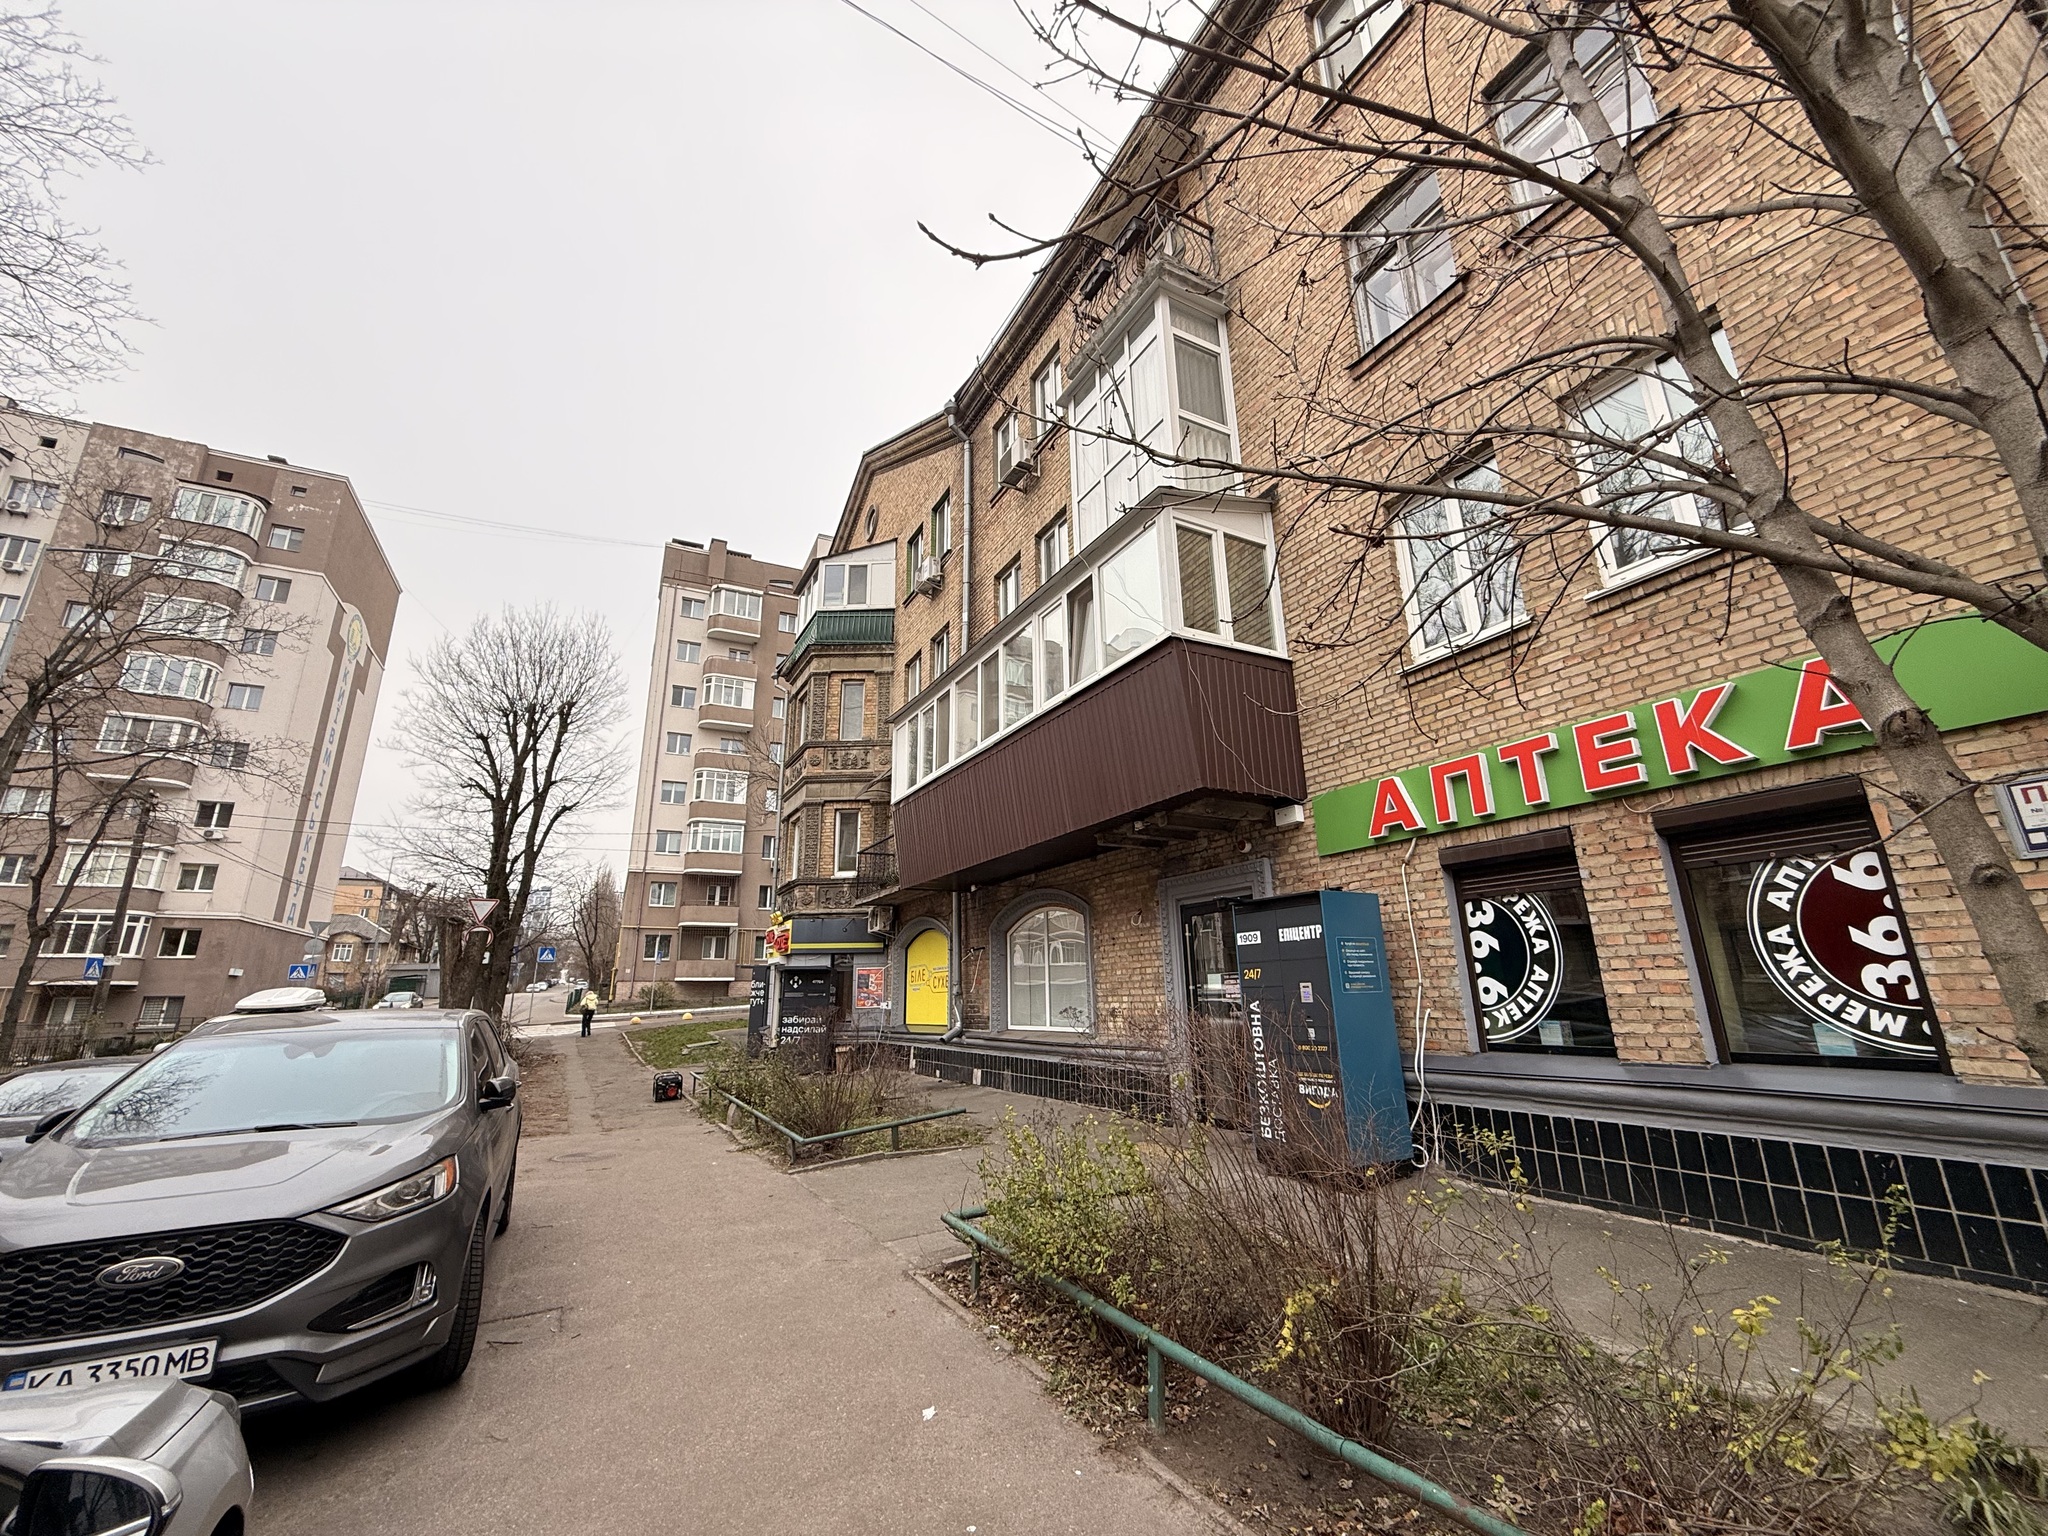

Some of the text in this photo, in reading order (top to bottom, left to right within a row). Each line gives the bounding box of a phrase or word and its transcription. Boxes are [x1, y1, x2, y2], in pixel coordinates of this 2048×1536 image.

[1368, 655, 1874, 840] АПТЕКА
[1766, 854, 1817, 912] АПТ
[1239, 933, 1259, 943] 1909
[1278, 925, 1322, 942] ЕПІЦЕНТР
[1491, 893, 1551, 1028] РЕЖА АПТЕК
[910, 968, 926, 984] БІЛЕ
[1766, 924, 1908, 1037] МЕРЕЖА
[781, 1025, 827, 1034] надсилай
[115, 1263, 165, 1283] Ford
